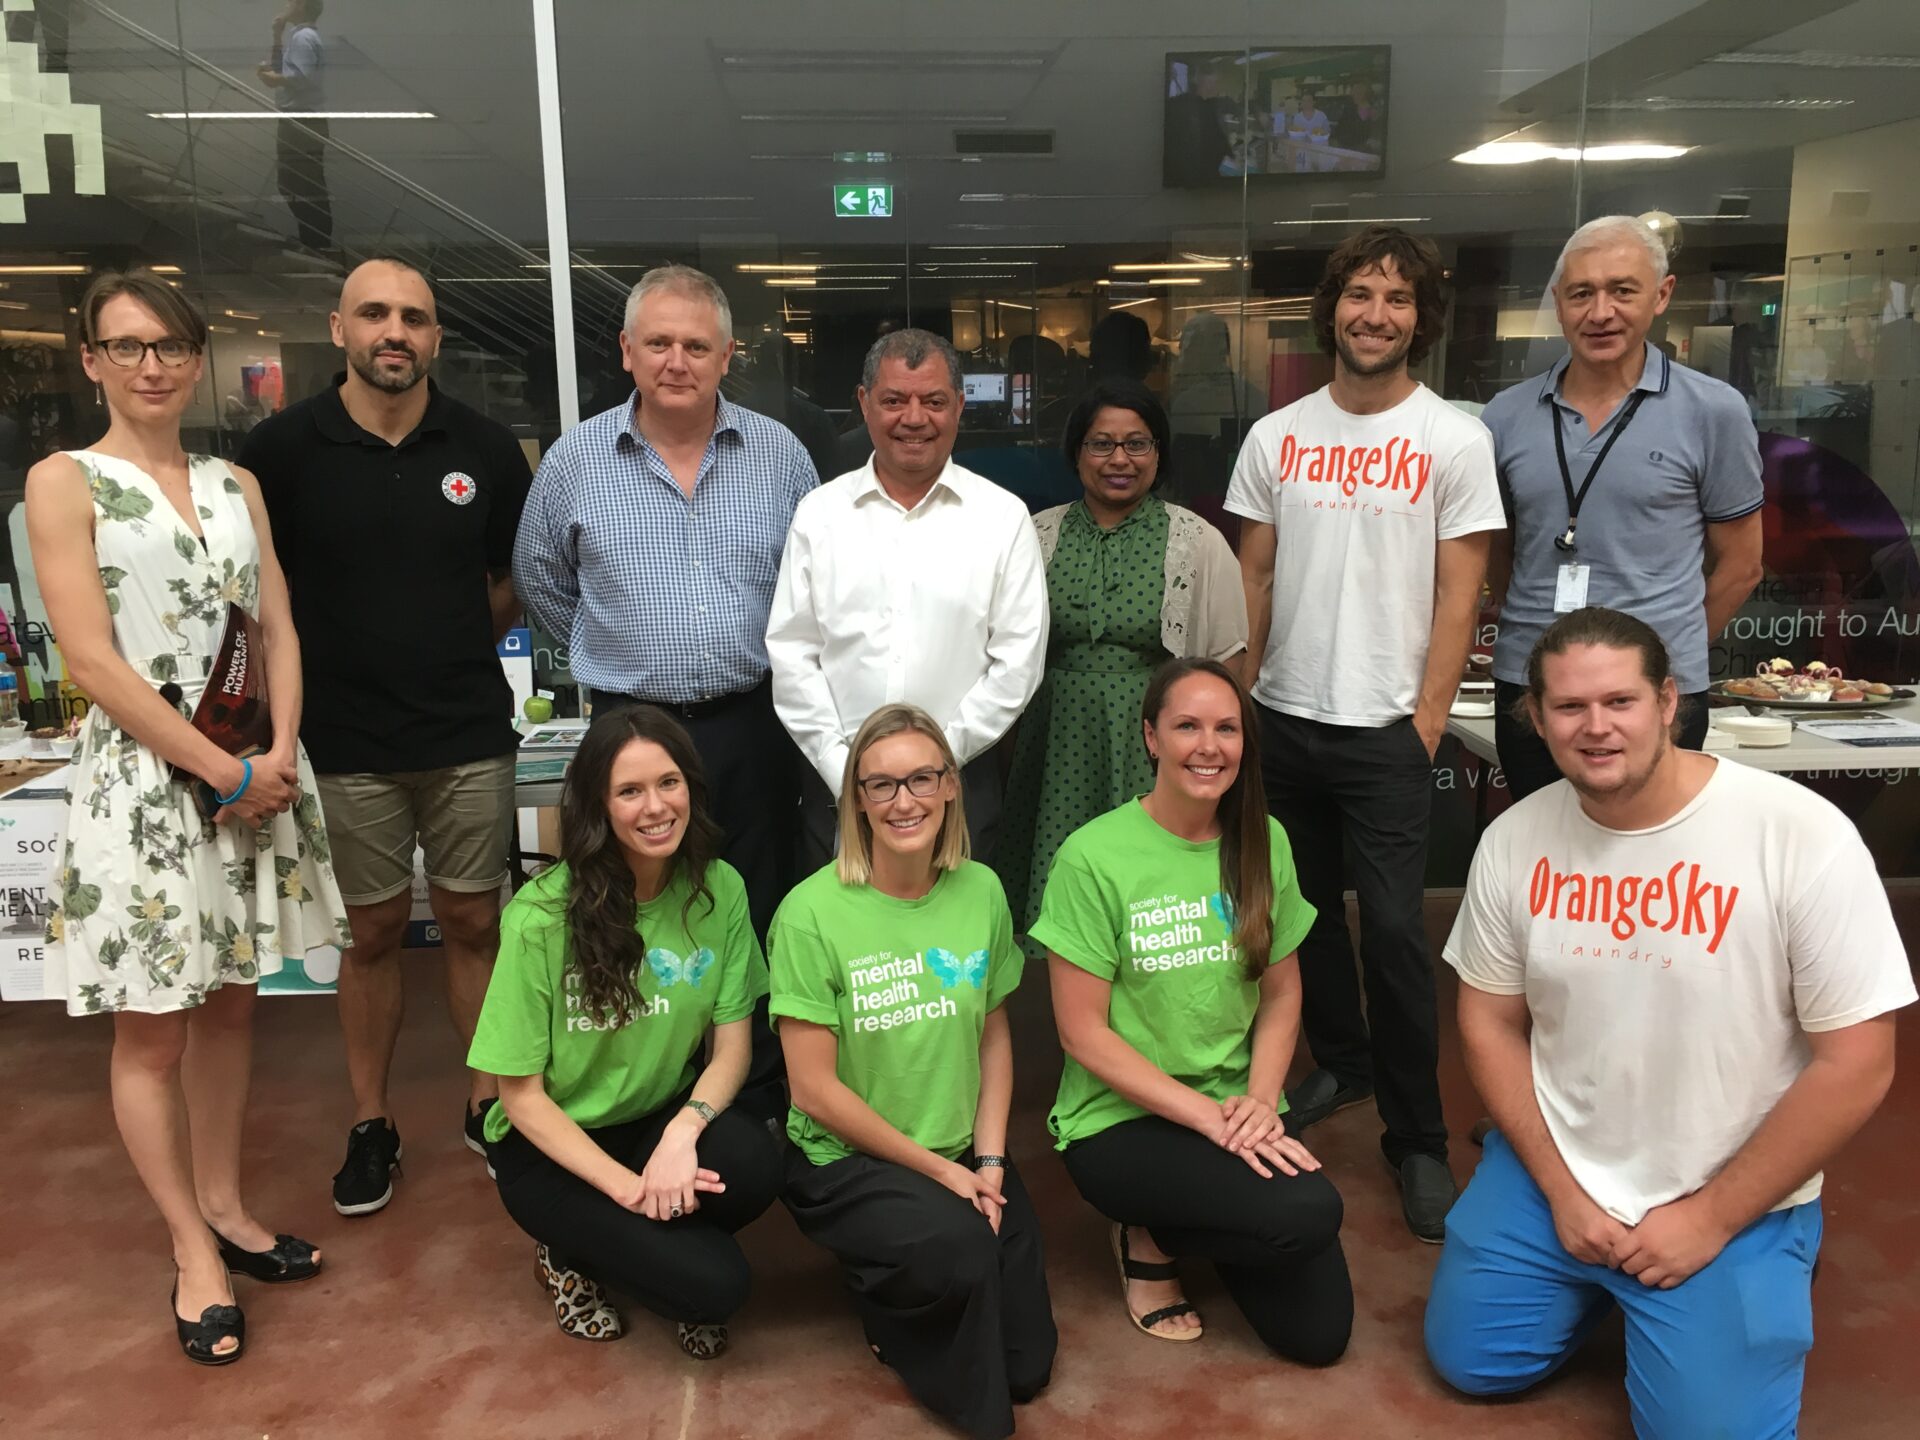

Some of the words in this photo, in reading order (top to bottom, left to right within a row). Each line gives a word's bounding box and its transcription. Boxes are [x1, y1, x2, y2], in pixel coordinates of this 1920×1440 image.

[1303, 499, 1383, 516] laundry
[1837, 609, 1868, 637] to
[222, 650, 241, 693] POWER
[235, 630, 243, 648] OF
[232, 630, 248, 696] HUMANITY
[1129, 897, 1161, 912] society
[1163, 893, 1179, 904] for
[1130, 896, 1208, 930] mental
[1529, 856, 1740, 955] OrangeSky
[1130, 922, 1202, 953] health
[18, 947, 44, 961] RE
[848, 953, 878, 969] society
[880, 950, 892, 961] for
[1132, 940, 1238, 972] research
[1560, 942, 1673, 968] laundry
[851, 952, 924, 989] mental
[852, 978, 919, 1013] health
[854, 995, 957, 1033] research
